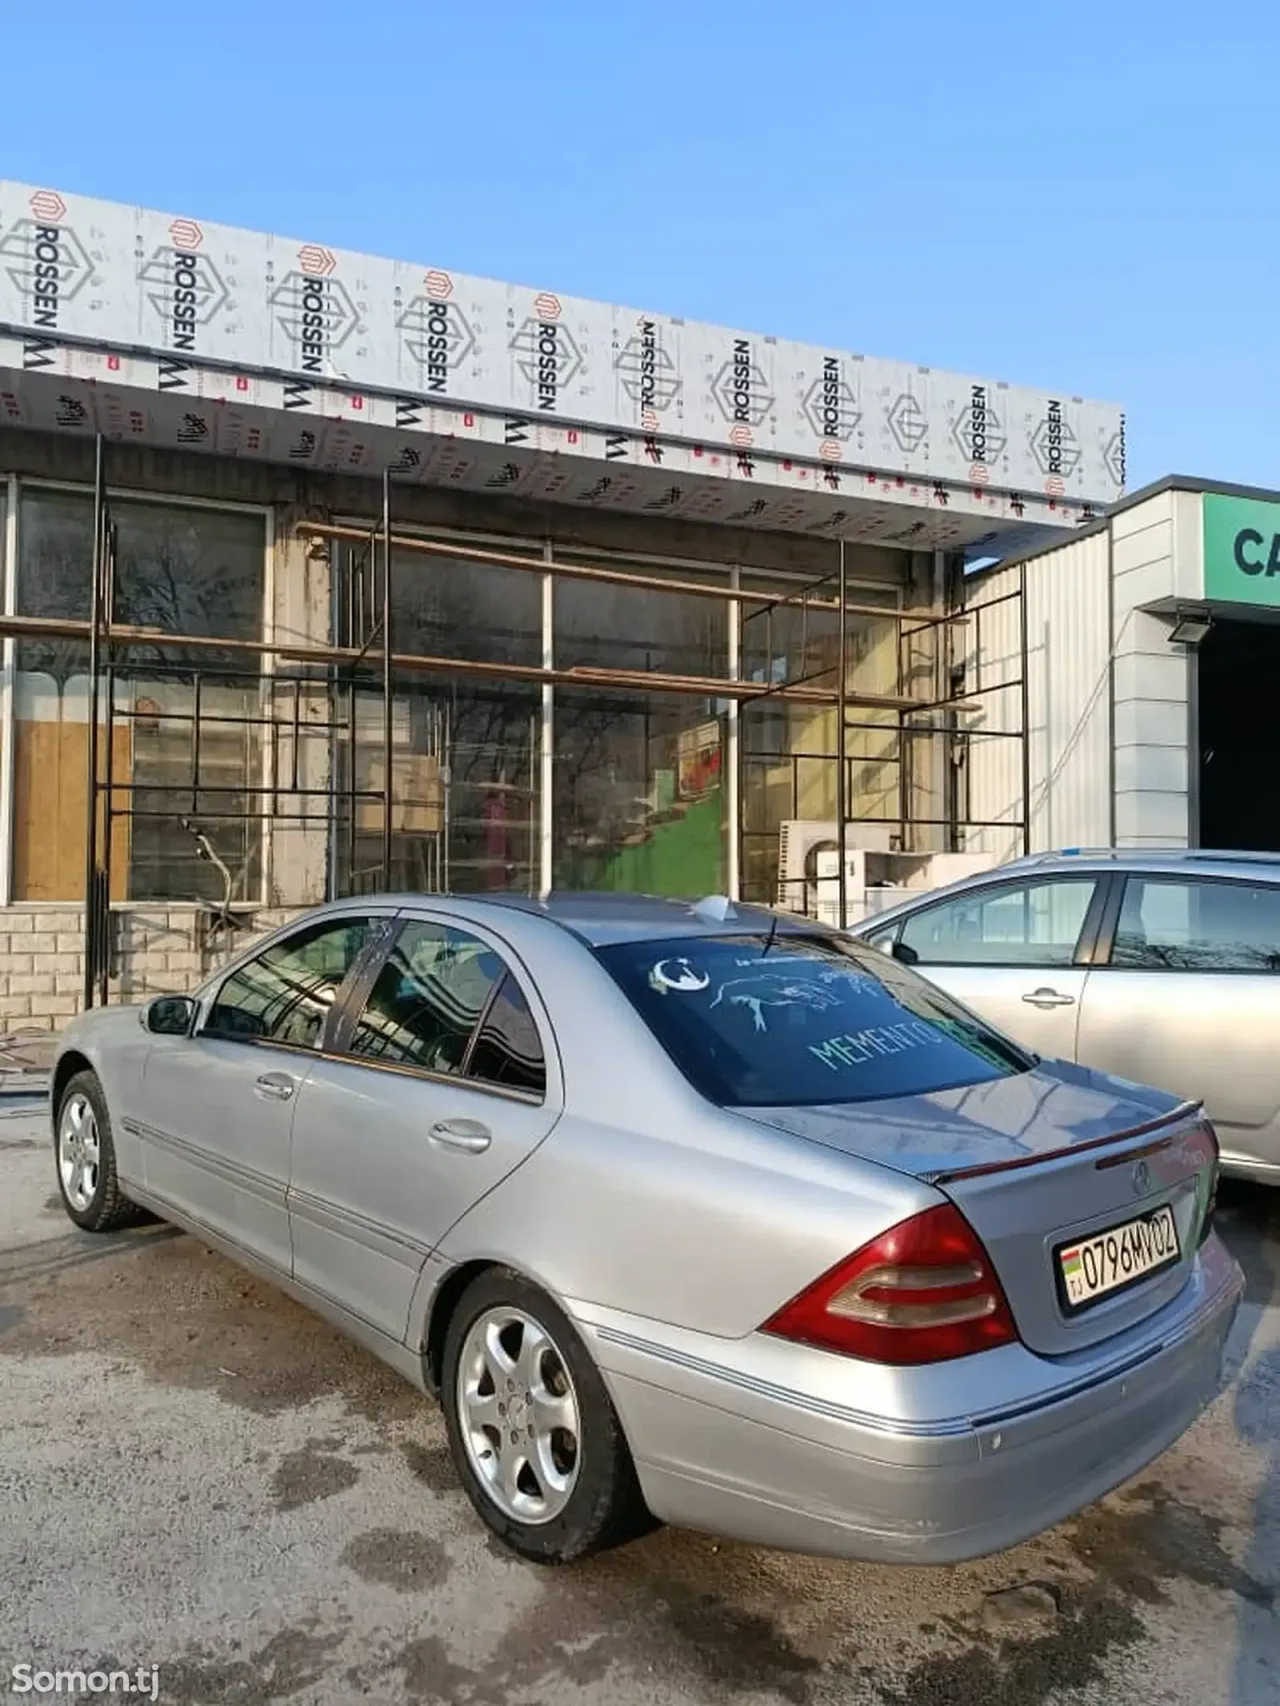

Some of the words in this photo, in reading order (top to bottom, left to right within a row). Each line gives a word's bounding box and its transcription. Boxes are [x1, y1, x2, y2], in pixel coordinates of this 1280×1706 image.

[33, 225, 59, 328] ROSSEN
[172, 251, 196, 351] ROSSEN
[301, 277, 323, 372] ROSSEN
[427, 301, 448, 393] ROSSEN
[537, 324, 557, 411] ROSSEN
[733, 339, 750, 421] ROSSEN
[823, 356, 839, 438] ROSSEN
[971, 385, 985, 463] ROSSEN
[1047, 400, 1061, 474] ROSSEN
[808, 1022, 942, 1071] MEMENTO
